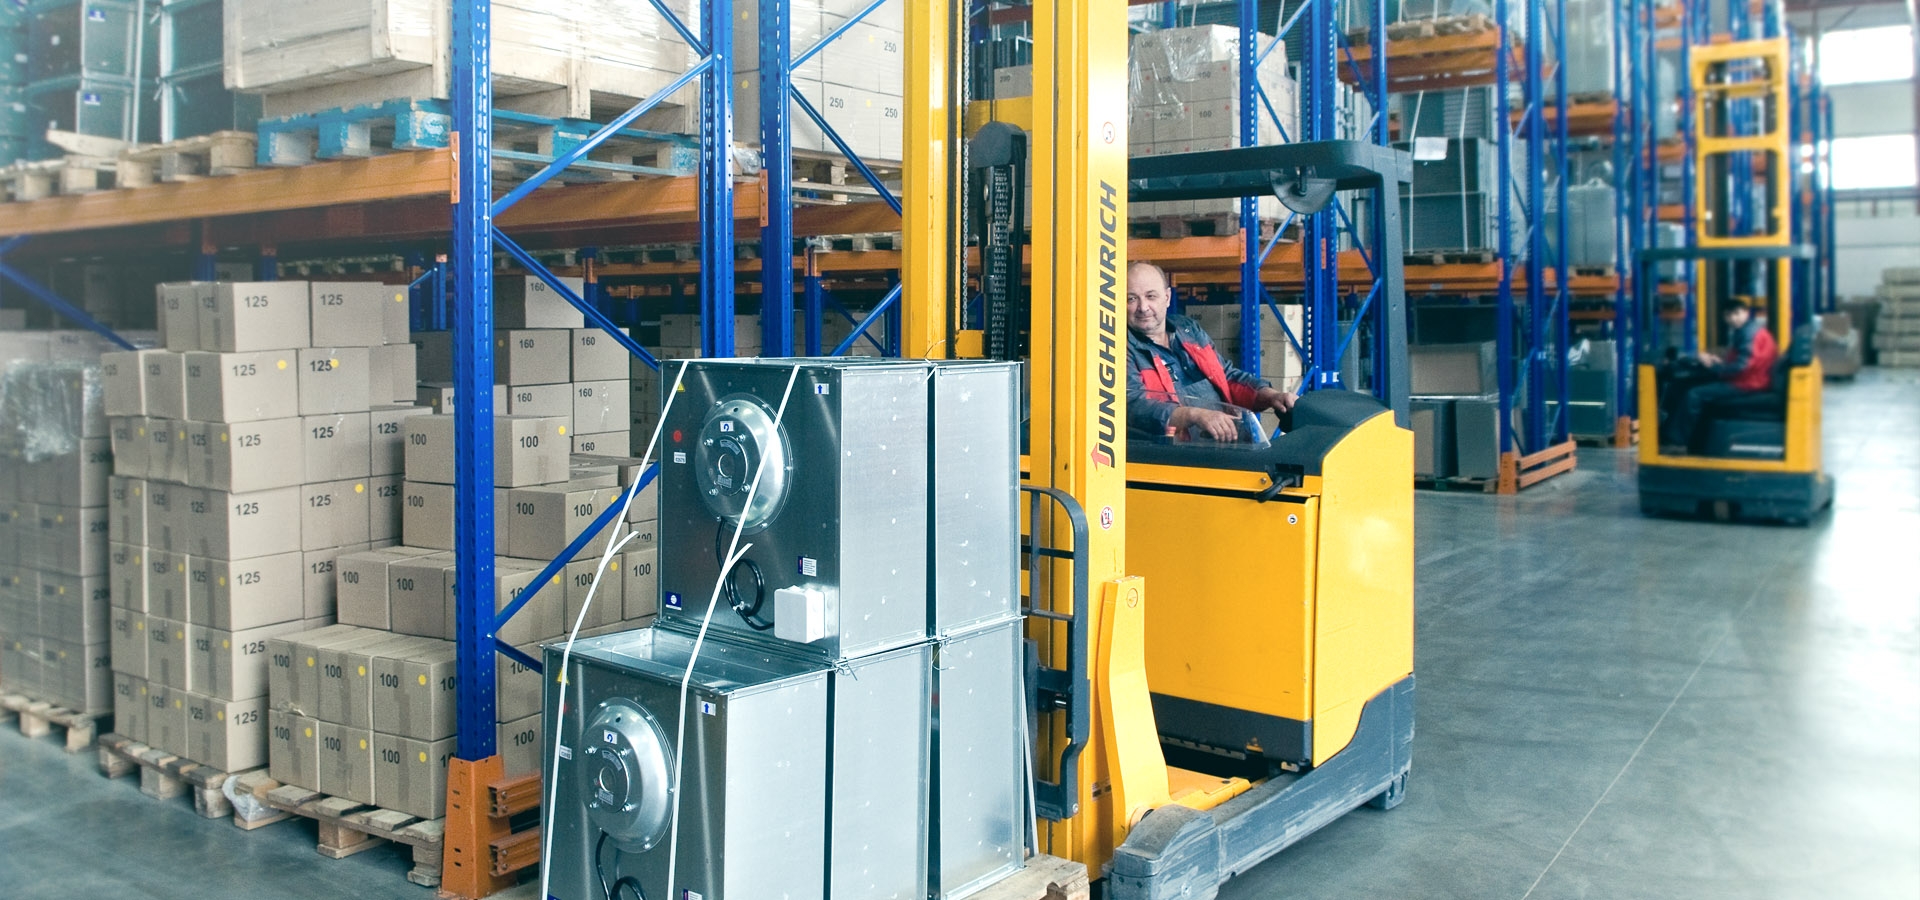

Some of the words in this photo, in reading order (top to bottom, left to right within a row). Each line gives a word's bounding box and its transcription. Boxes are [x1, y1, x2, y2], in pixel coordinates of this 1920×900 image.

[883, 41, 897, 53] 250
[829, 97, 844, 108] 250
[884, 107, 898, 118] 250
[530, 282, 545, 292] 160
[244, 296, 269, 308] 125
[320, 294, 344, 306] 125
[1097, 180, 1117, 468] JUNGHEINRICH
[519, 339, 535, 349] 160
[581, 336, 596, 346] 160
[232, 364, 257, 377] 125
[309, 360, 333, 372] 125
[517, 393, 533, 403] 160
[578, 388, 593, 398] 160
[312, 426, 334, 439] 125
[377, 422, 398, 434] 125
[153, 431, 168, 443] 125
[191, 434, 207, 446] 125
[237, 434, 262, 448] 125
[410, 433, 427, 445] 100
[519, 435, 539, 448] 100
[580, 441, 595, 452] 160
[377, 485, 399, 498] 125
[190, 501, 205, 513] 125
[309, 494, 332, 507] 125
[407, 495, 424, 508] 100
[235, 502, 259, 516] 125
[515, 501, 535, 515] 100
[573, 503, 593, 517] 100
[311, 560, 333, 574] 125
[633, 563, 651, 577] 100
[192, 570, 207, 583] 125
[236, 571, 261, 585] 125
[342, 571, 359, 584] 100
[574, 572, 594, 587] 100
[396, 577, 414, 591] 100
[510, 587, 524, 599] 10
[242, 640, 266, 655] 125
[273, 654, 290, 668] 100
[324, 664, 342, 678] 100
[379, 673, 399, 688] 100
[440, 676, 457, 691] 10
[190, 706, 204, 720] 125
[234, 710, 258, 726] 125
[274, 726, 290, 741] 100
[513, 729, 535, 746] 100
[324, 736, 342, 751] 100
[382, 749, 400, 764] 100
